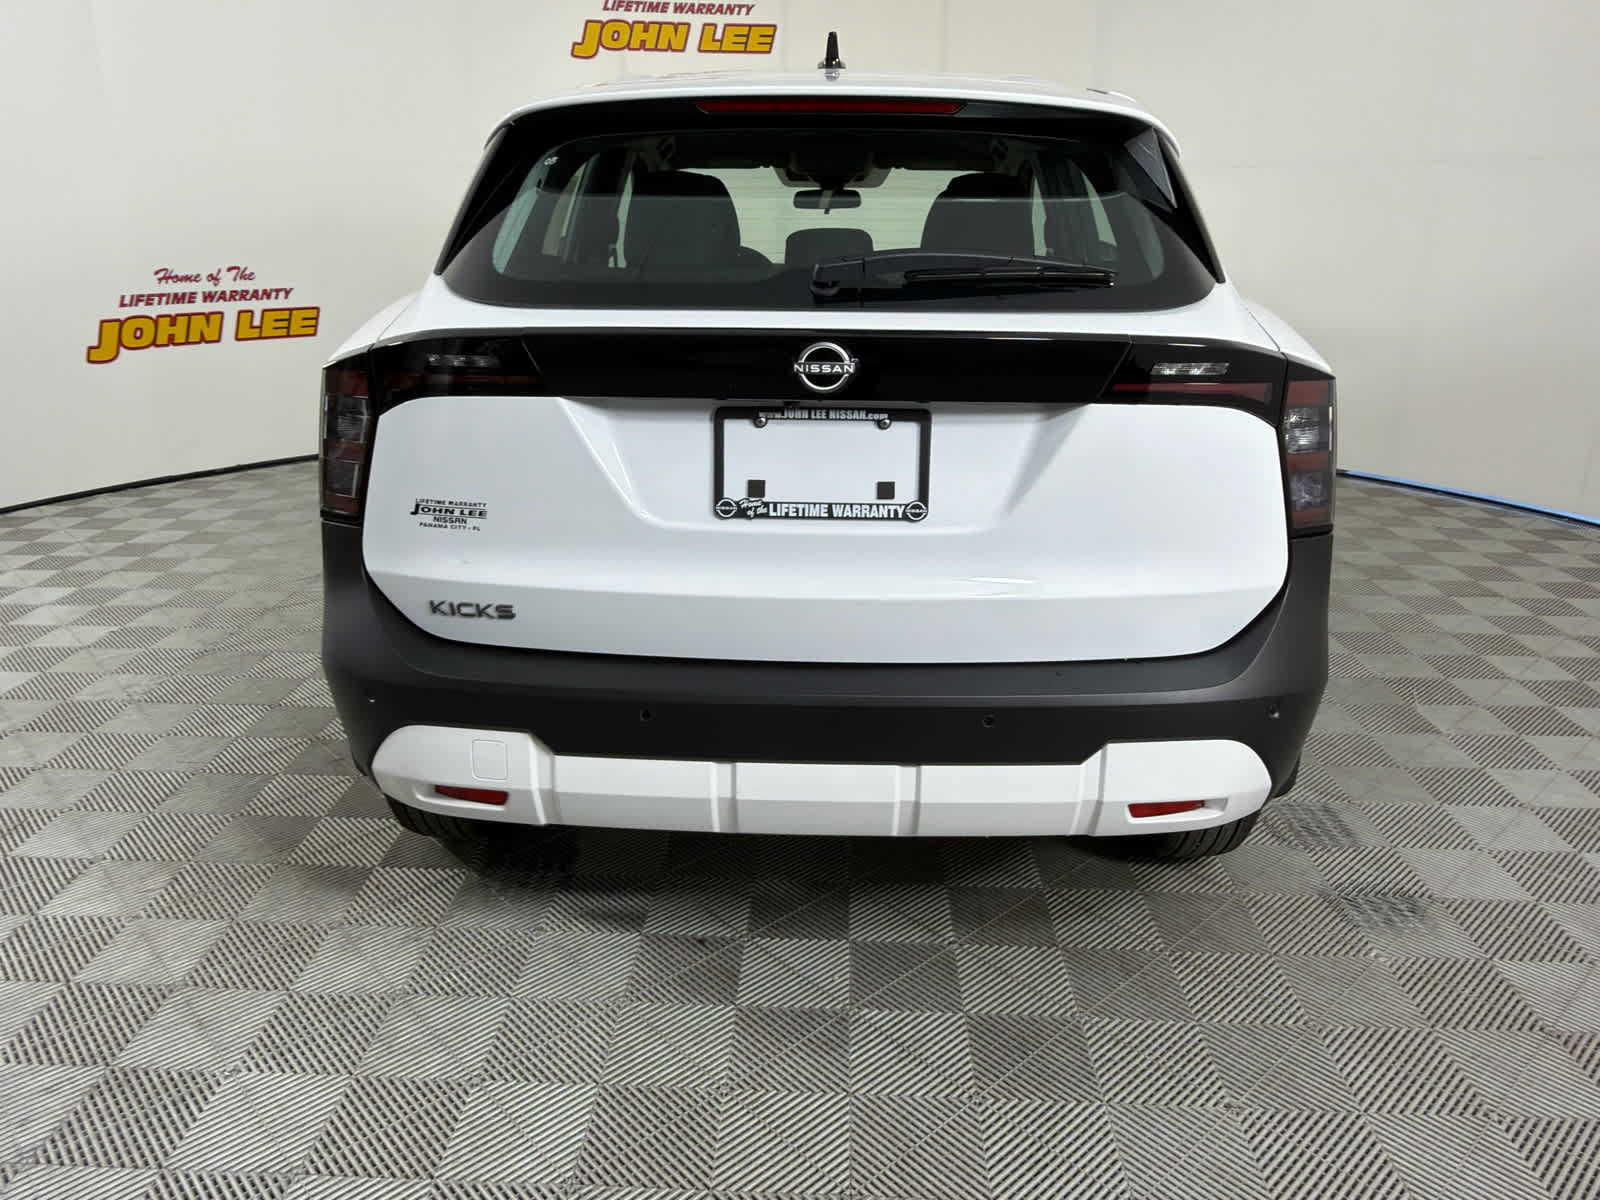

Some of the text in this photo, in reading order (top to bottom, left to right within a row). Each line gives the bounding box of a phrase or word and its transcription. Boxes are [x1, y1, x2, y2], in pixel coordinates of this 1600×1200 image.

[602, 0, 755, 16] LIFETIME WARRANTY
[571, 19, 777, 59] JOHN LEE
[153, 265, 256, 286] Home of The
[119, 287, 294, 308] LIFETIME WARRANTY
[87, 306, 320, 364] JOHN LEE
[793, 364, 855, 373] NISSAN
[811, 409, 826, 420] LEE
[409, 503, 488, 517] JOHN LEE
[769, 503, 829, 518] LIFETIME
[831, 504, 906, 519] WARRANTY
[433, 516, 467, 525] NISSAN
[429, 600, 517, 620] KICKS
